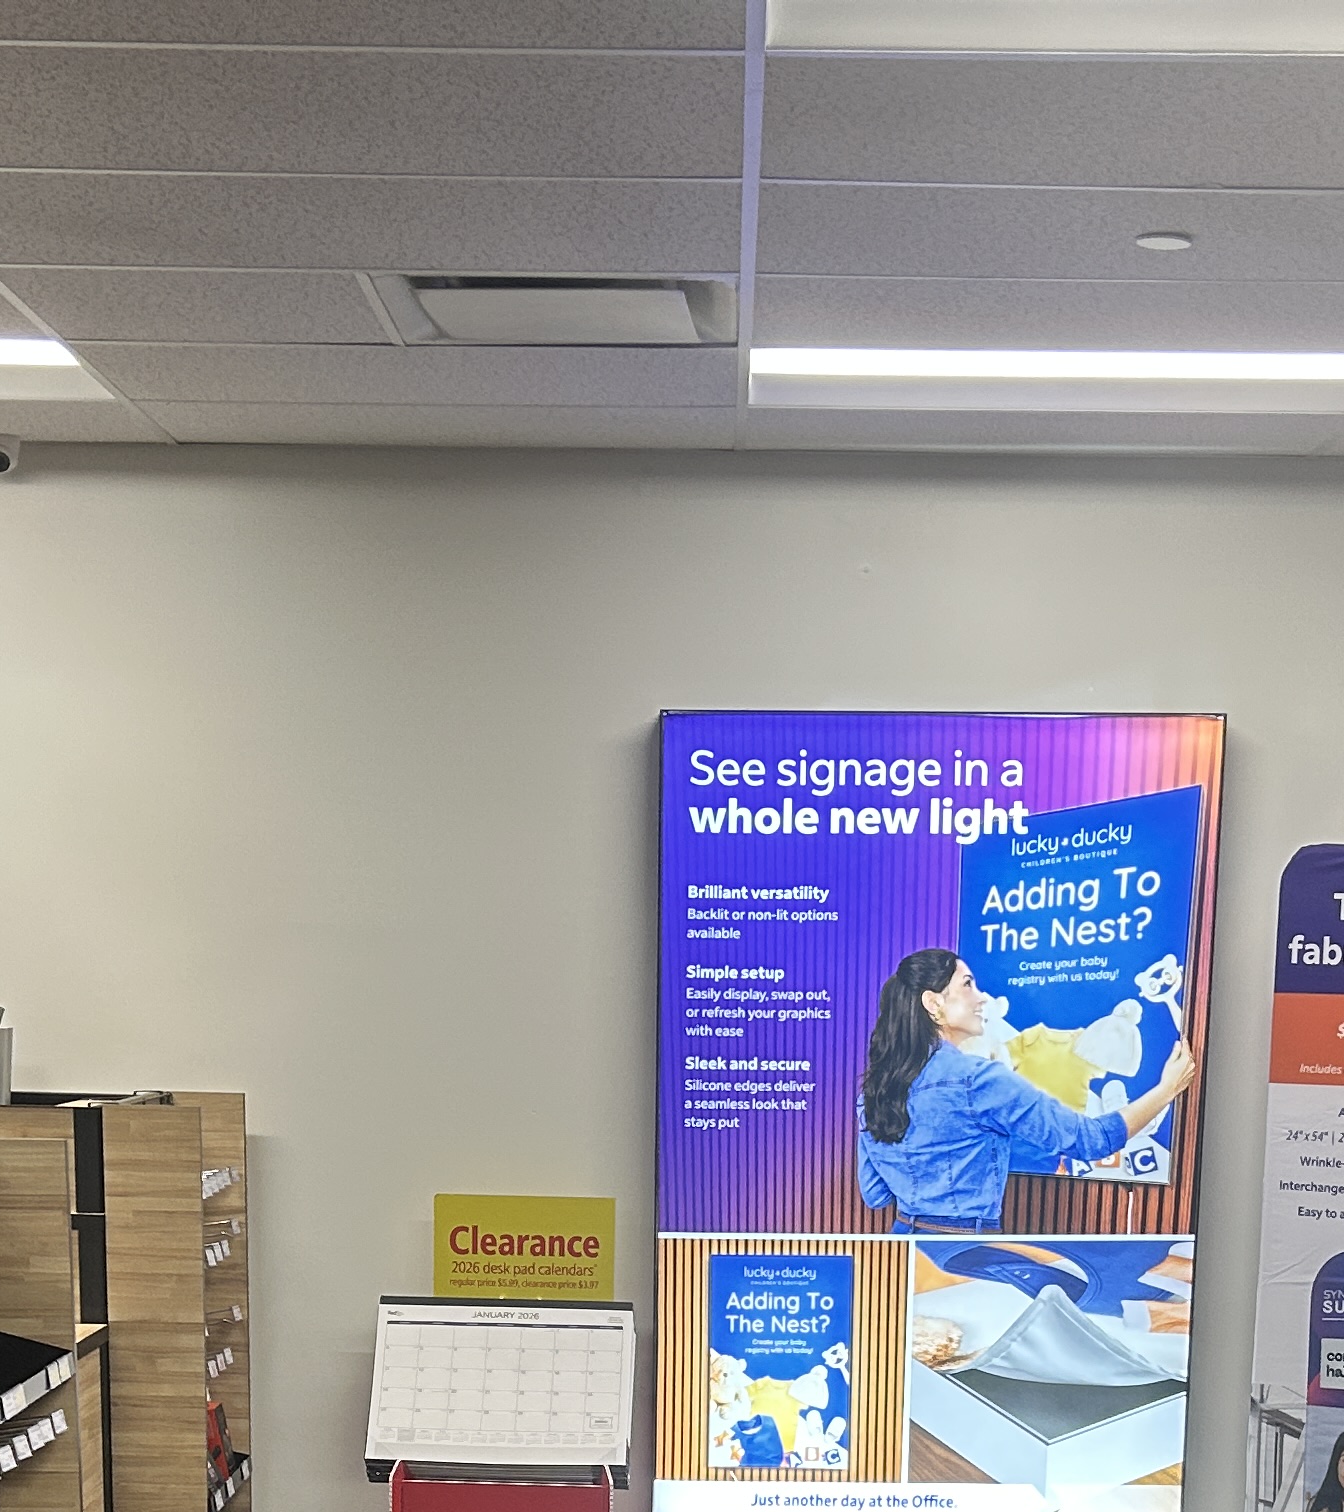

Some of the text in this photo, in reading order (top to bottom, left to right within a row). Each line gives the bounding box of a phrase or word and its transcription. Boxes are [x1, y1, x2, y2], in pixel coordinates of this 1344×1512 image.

[690, 750, 1023, 796] See signage in a
[688, 797, 1029, 845] whole new light
[1011, 823, 1132, 856] lucky ducky
[687, 885, 829, 903] Brilliant versatility
[982, 867, 1161, 915] Adding To
[687, 908, 838, 922] Backlit or non-lit options
[687, 928, 741, 939] available
[980, 906, 1152, 953] The Nest?
[1019, 956, 1108, 971] Create your baby
[686, 965, 785, 982] Simple setup
[1008, 969, 1119, 987] registry with us today!
[686, 987, 831, 1002] Easily display, swap out,
[686, 1006, 831, 1022] or refresh your graphics
[685, 1025, 744, 1036] with ease
[685, 1056, 810, 1071] Sleek and secure
[1300, 1063, 1342, 1075] Includes
[684, 1079, 815, 1094] Silicone edges deliver
[684, 1098, 807, 1110] a seamless look that
[684, 1117, 739, 1130] stays put
[1298, 1206, 1323, 1220] Easy
[1325, 1208, 1337, 1218] to
[450, 1225, 600, 1258] Clearance
[451, 1261, 480, 1274] 2026
[483, 1262, 510, 1274] desk
[513, 1263, 535, 1276] pad
[726, 1291, 834, 1314] Adding To
[725, 1314, 830, 1333] The Nest?
[751, 1494, 958, 1511] Just another day at the Office.
